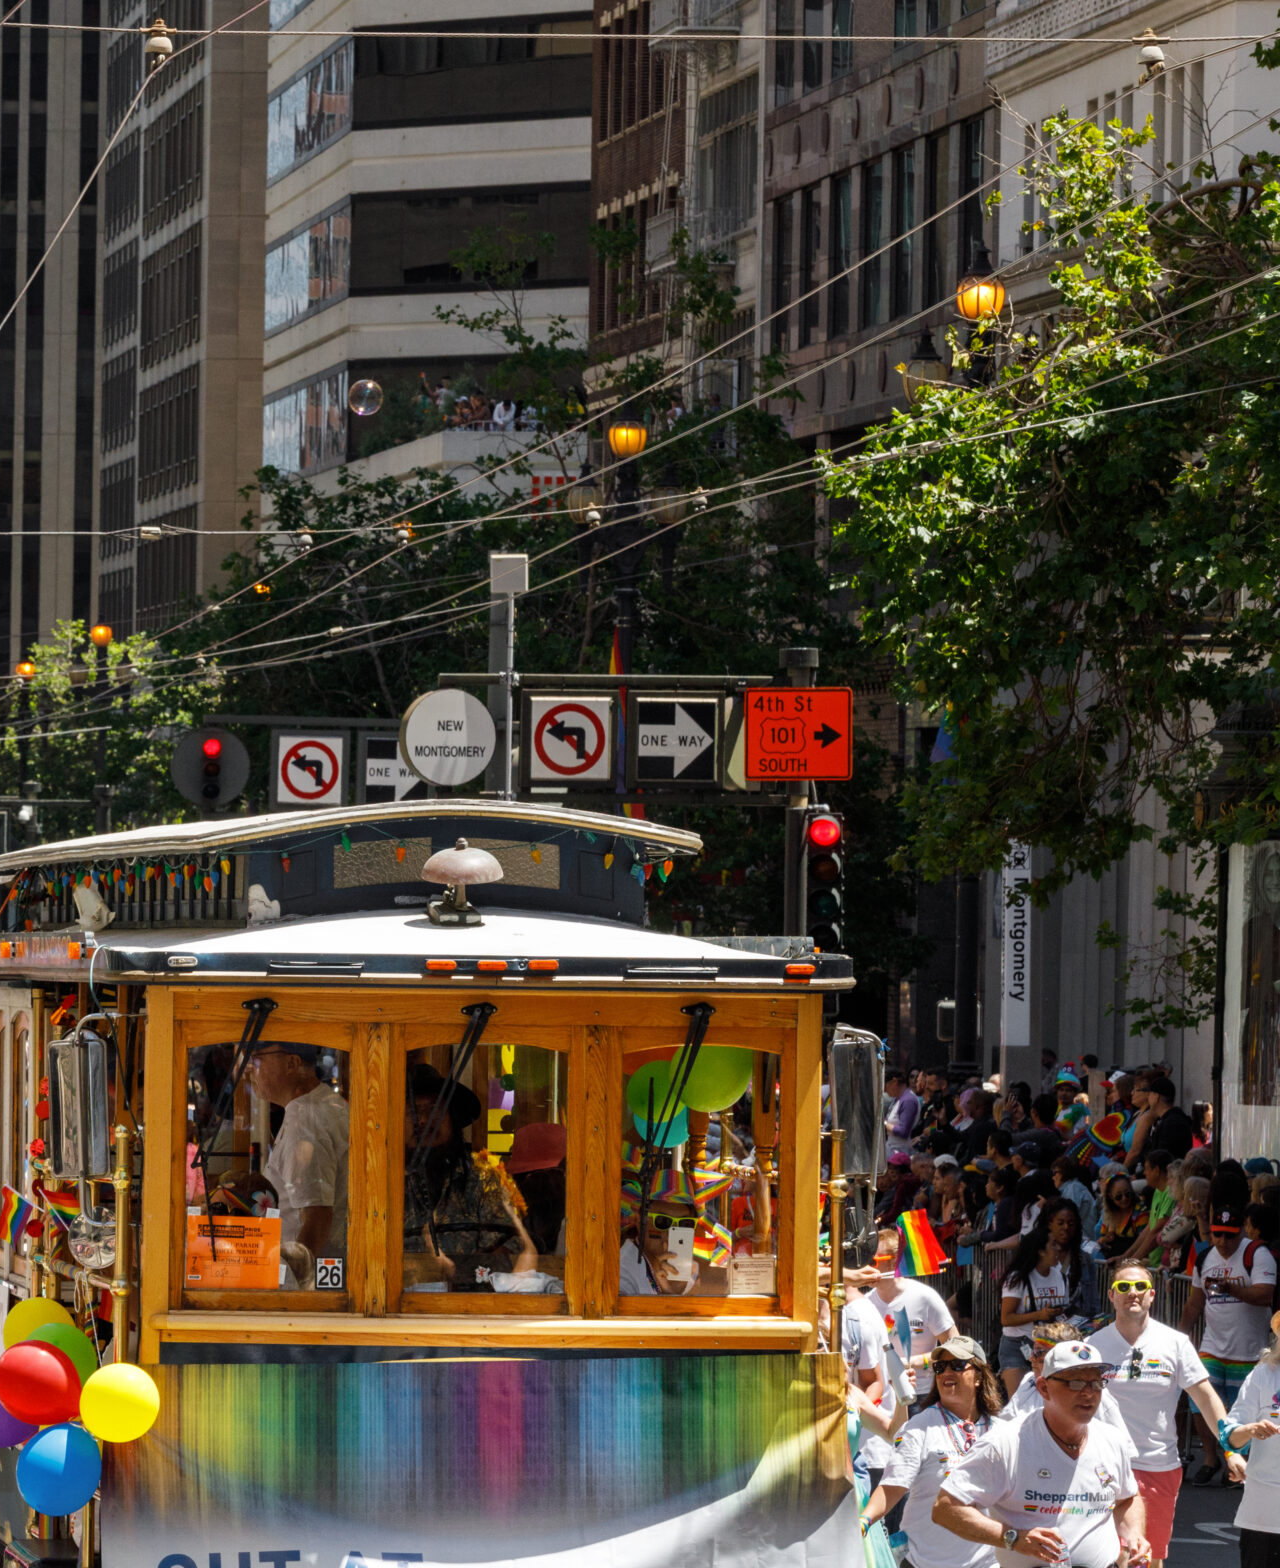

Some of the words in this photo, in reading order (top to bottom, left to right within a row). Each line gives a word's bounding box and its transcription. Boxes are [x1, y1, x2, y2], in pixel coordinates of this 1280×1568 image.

[753, 695, 785, 712] 4th
[794, 695, 814, 712] St
[437, 720, 464, 732] NEW
[641, 734, 669, 747] ONE
[677, 734, 706, 748] WAY
[771, 727, 796, 744] 101
[414, 745, 486, 759] MONTGOMERY
[758, 758, 808, 772] SOUTH
[369, 767, 391, 778] ONE
[398, 767, 417, 778] WA
[1009, 877, 1029, 1002] Montgomery
[318, 1265, 342, 1287] 26
[1039, 1504, 1085, 1516] celebrates
[1086, 1504, 1110, 1518] pride
